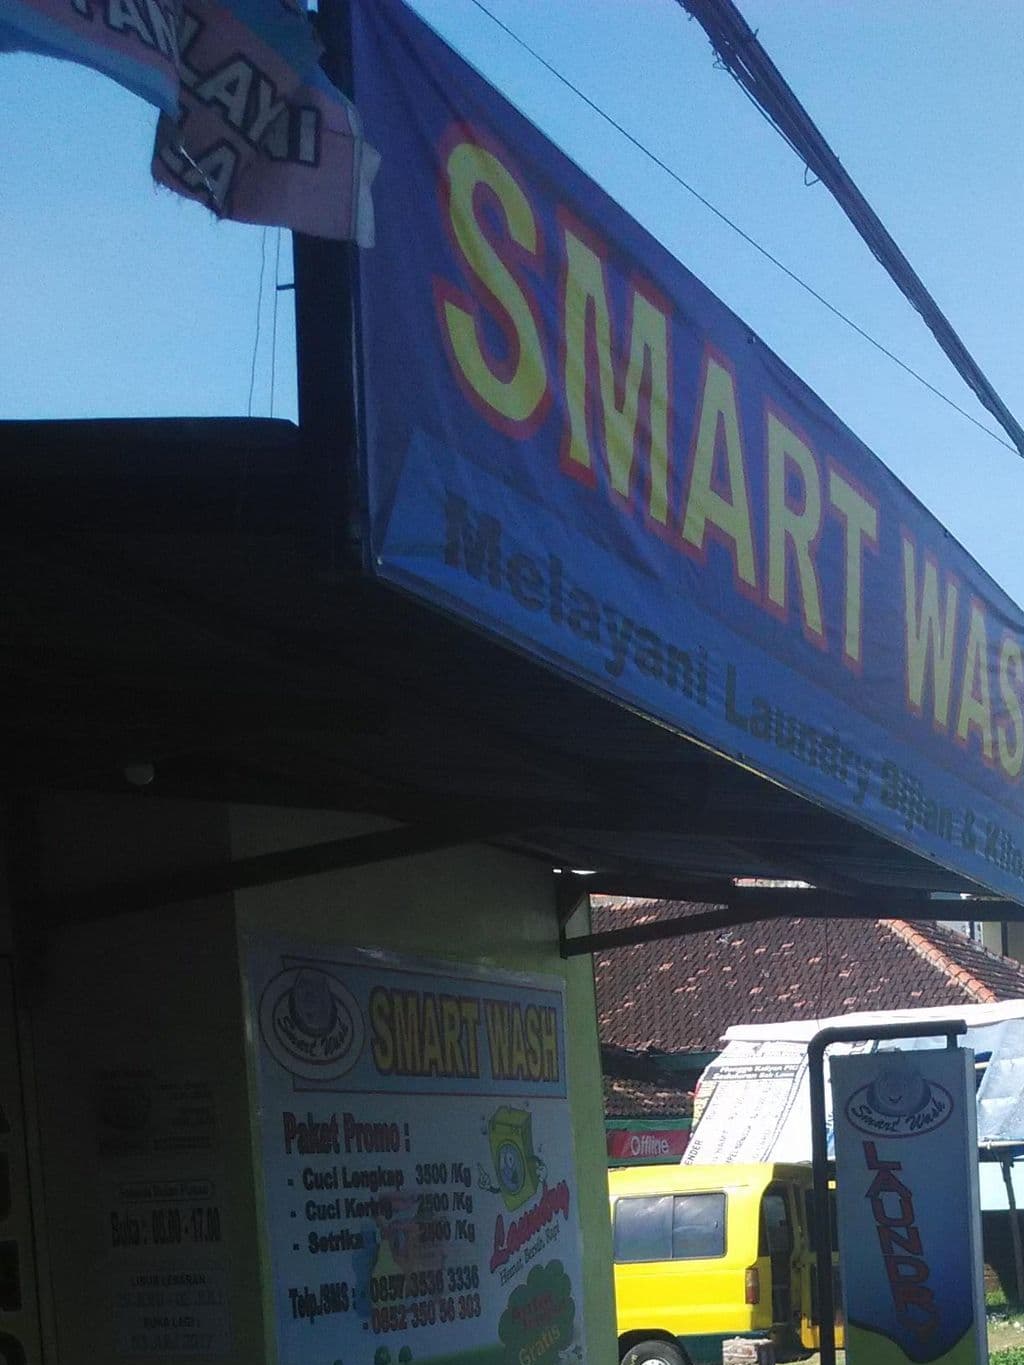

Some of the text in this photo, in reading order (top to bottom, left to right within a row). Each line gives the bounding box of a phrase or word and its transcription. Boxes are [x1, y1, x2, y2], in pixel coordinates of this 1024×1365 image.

[434, 125, 880, 672] SMART
[445, 492, 708, 707] Melayani
[724, 664, 873, 806] Laundry
[962, 808, 978, 850] &
[368, 985, 560, 1083] SMART WASH
[282, 1111, 341, 1155] Paket
[343, 1111, 400, 1153] Promo
[850, 1097, 947, 1133] Smart Wash
[630, 1135, 670, 1157] Offline
[303, 1162, 472, 1193] Cuci Lengkap 3500 /Kg
[305, 1191, 473, 1221] Cuci Kering 2500 /Kg
[111, 1210, 140, 1247] Buka
[192, 1207, 222, 1243] 17.00
[308, 1228, 364, 1254] Setrika
[455, 1219, 476, 1243] /Kg
[862, 1140, 939, 1344] LAUNDRY
[370, 1274, 405, 1303] 0857
[446, 1265, 480, 1293] 3336
